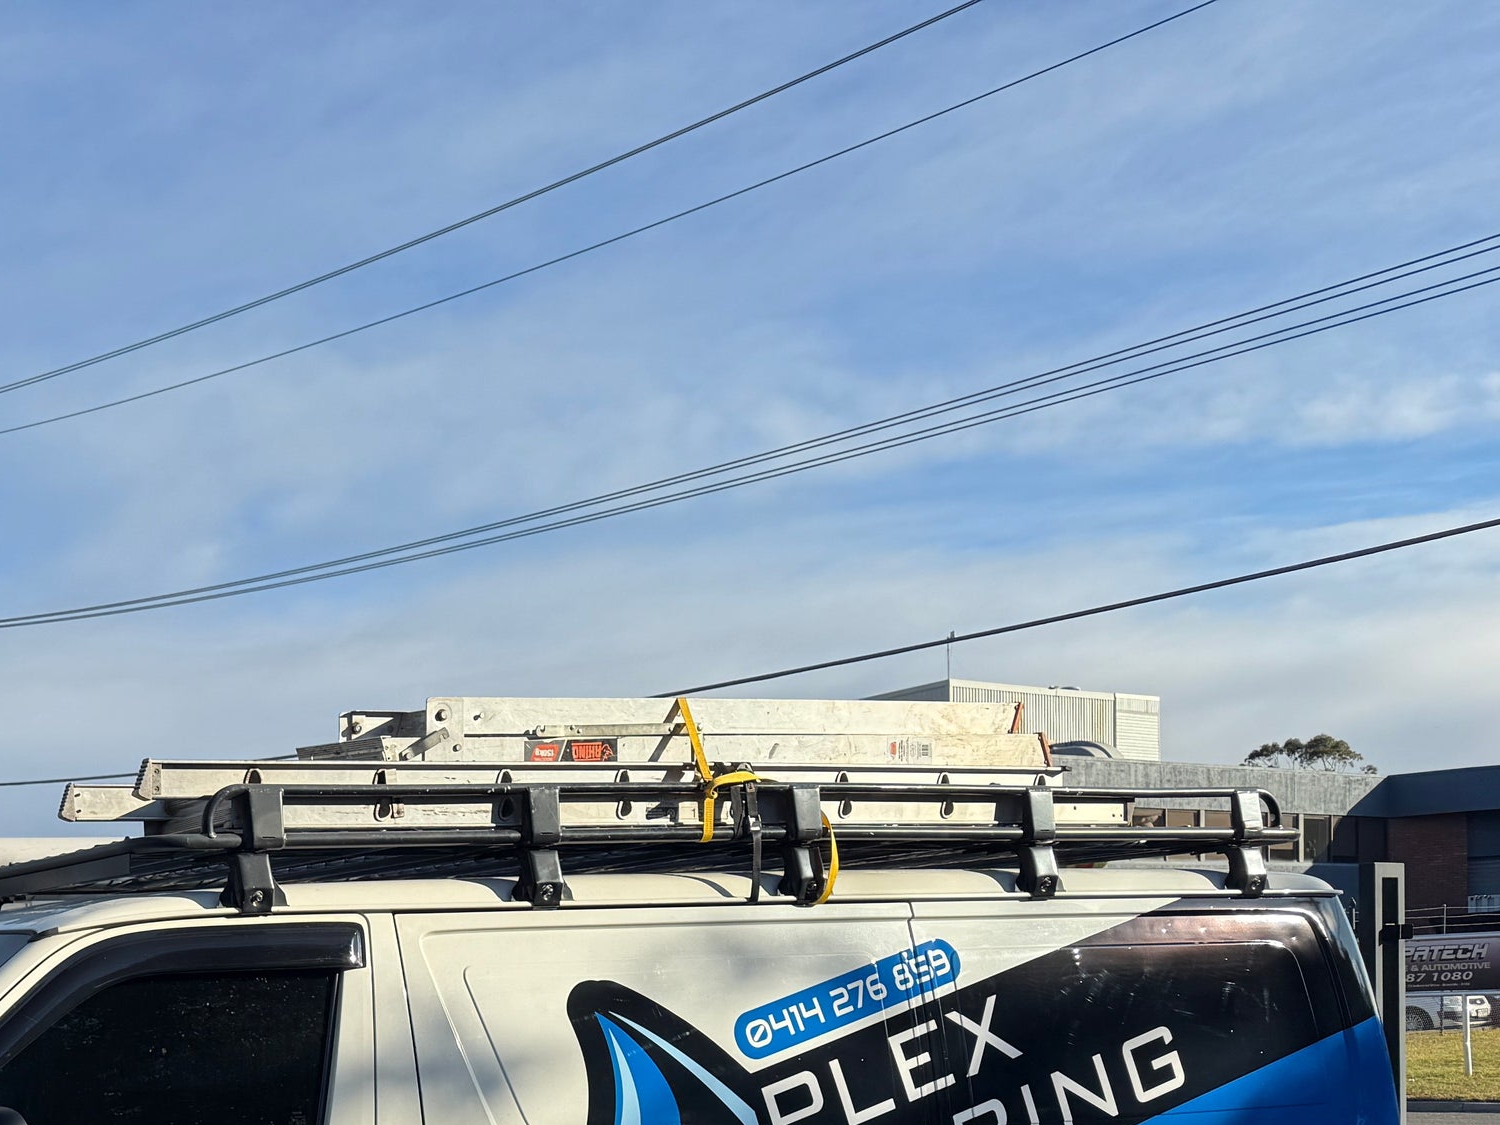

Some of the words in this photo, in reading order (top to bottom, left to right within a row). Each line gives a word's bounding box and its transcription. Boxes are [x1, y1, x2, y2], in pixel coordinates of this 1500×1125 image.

[1421, 962, 1491, 971] AUTOMOTIVE
[1432, 971, 1473, 982] 1080
[745, 996, 826, 1049] 0414
[829, 973, 888, 1017] 276
[892, 948, 952, 991] 859
